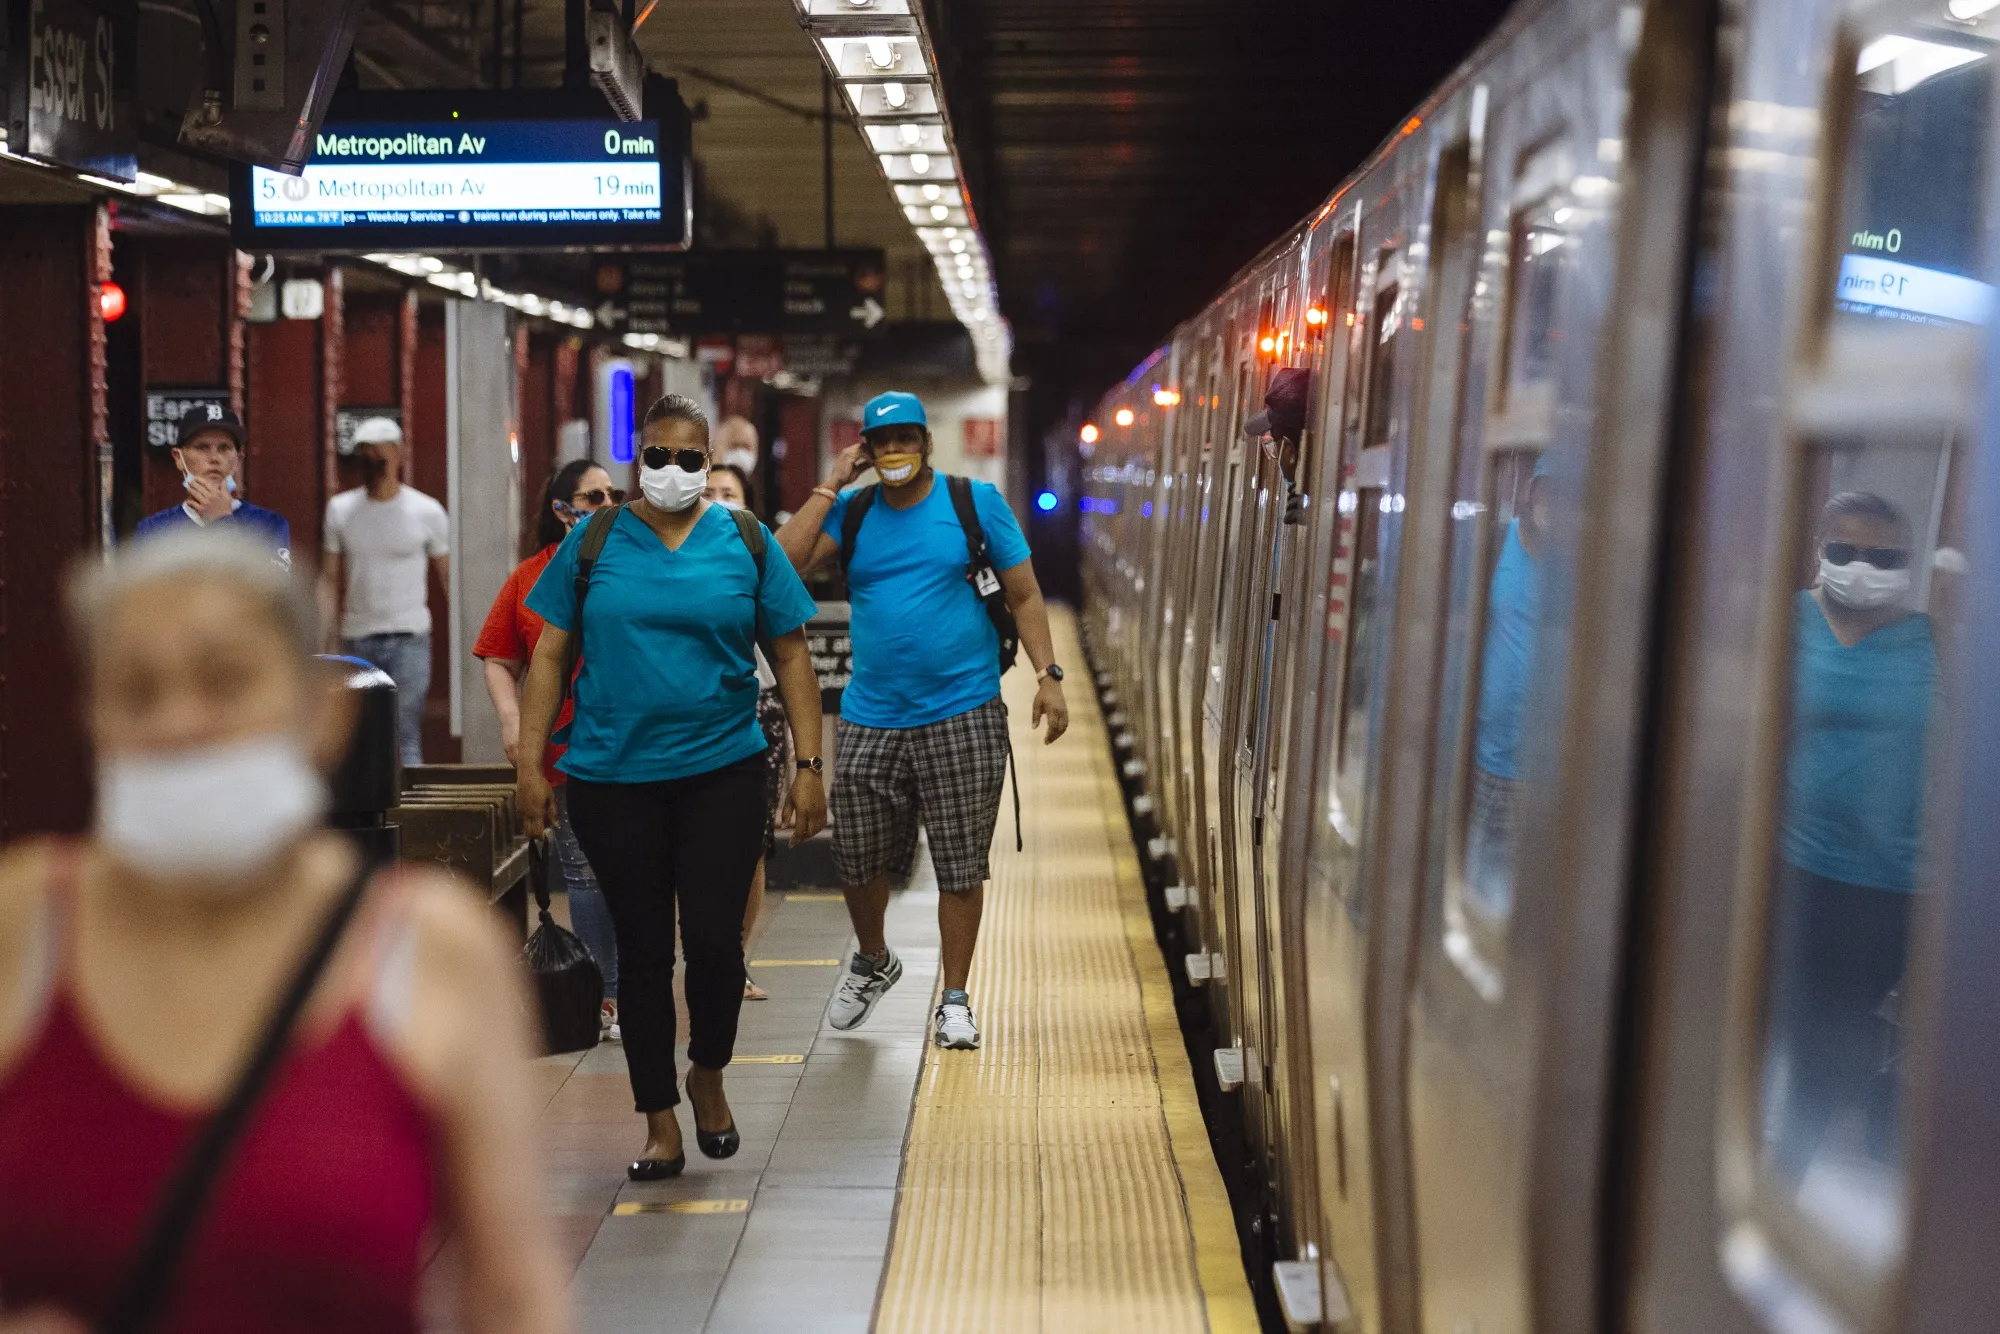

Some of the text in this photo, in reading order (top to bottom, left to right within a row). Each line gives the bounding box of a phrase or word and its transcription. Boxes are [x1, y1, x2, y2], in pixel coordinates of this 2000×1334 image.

[316, 133, 486, 160] Metropolitan Av
[604, 129, 655, 155] 0 min
[319, 178, 486, 200] Metropolitan Av
[593, 174, 655, 196] 19 min
[287, 211, 304, 223] AM
[367, 211, 410, 224] Weekday
[410, 211, 445, 223] Service
[473, 210, 500, 222] trains
[501, 211, 518, 222] run
[518, 210, 548, 223] during
[549, 210, 571, 221] rush
[571, 210, 598, 221] hours
[599, 209, 621, 222] only.
[622, 208, 645, 220] Take
[646, 208, 661, 220] the
